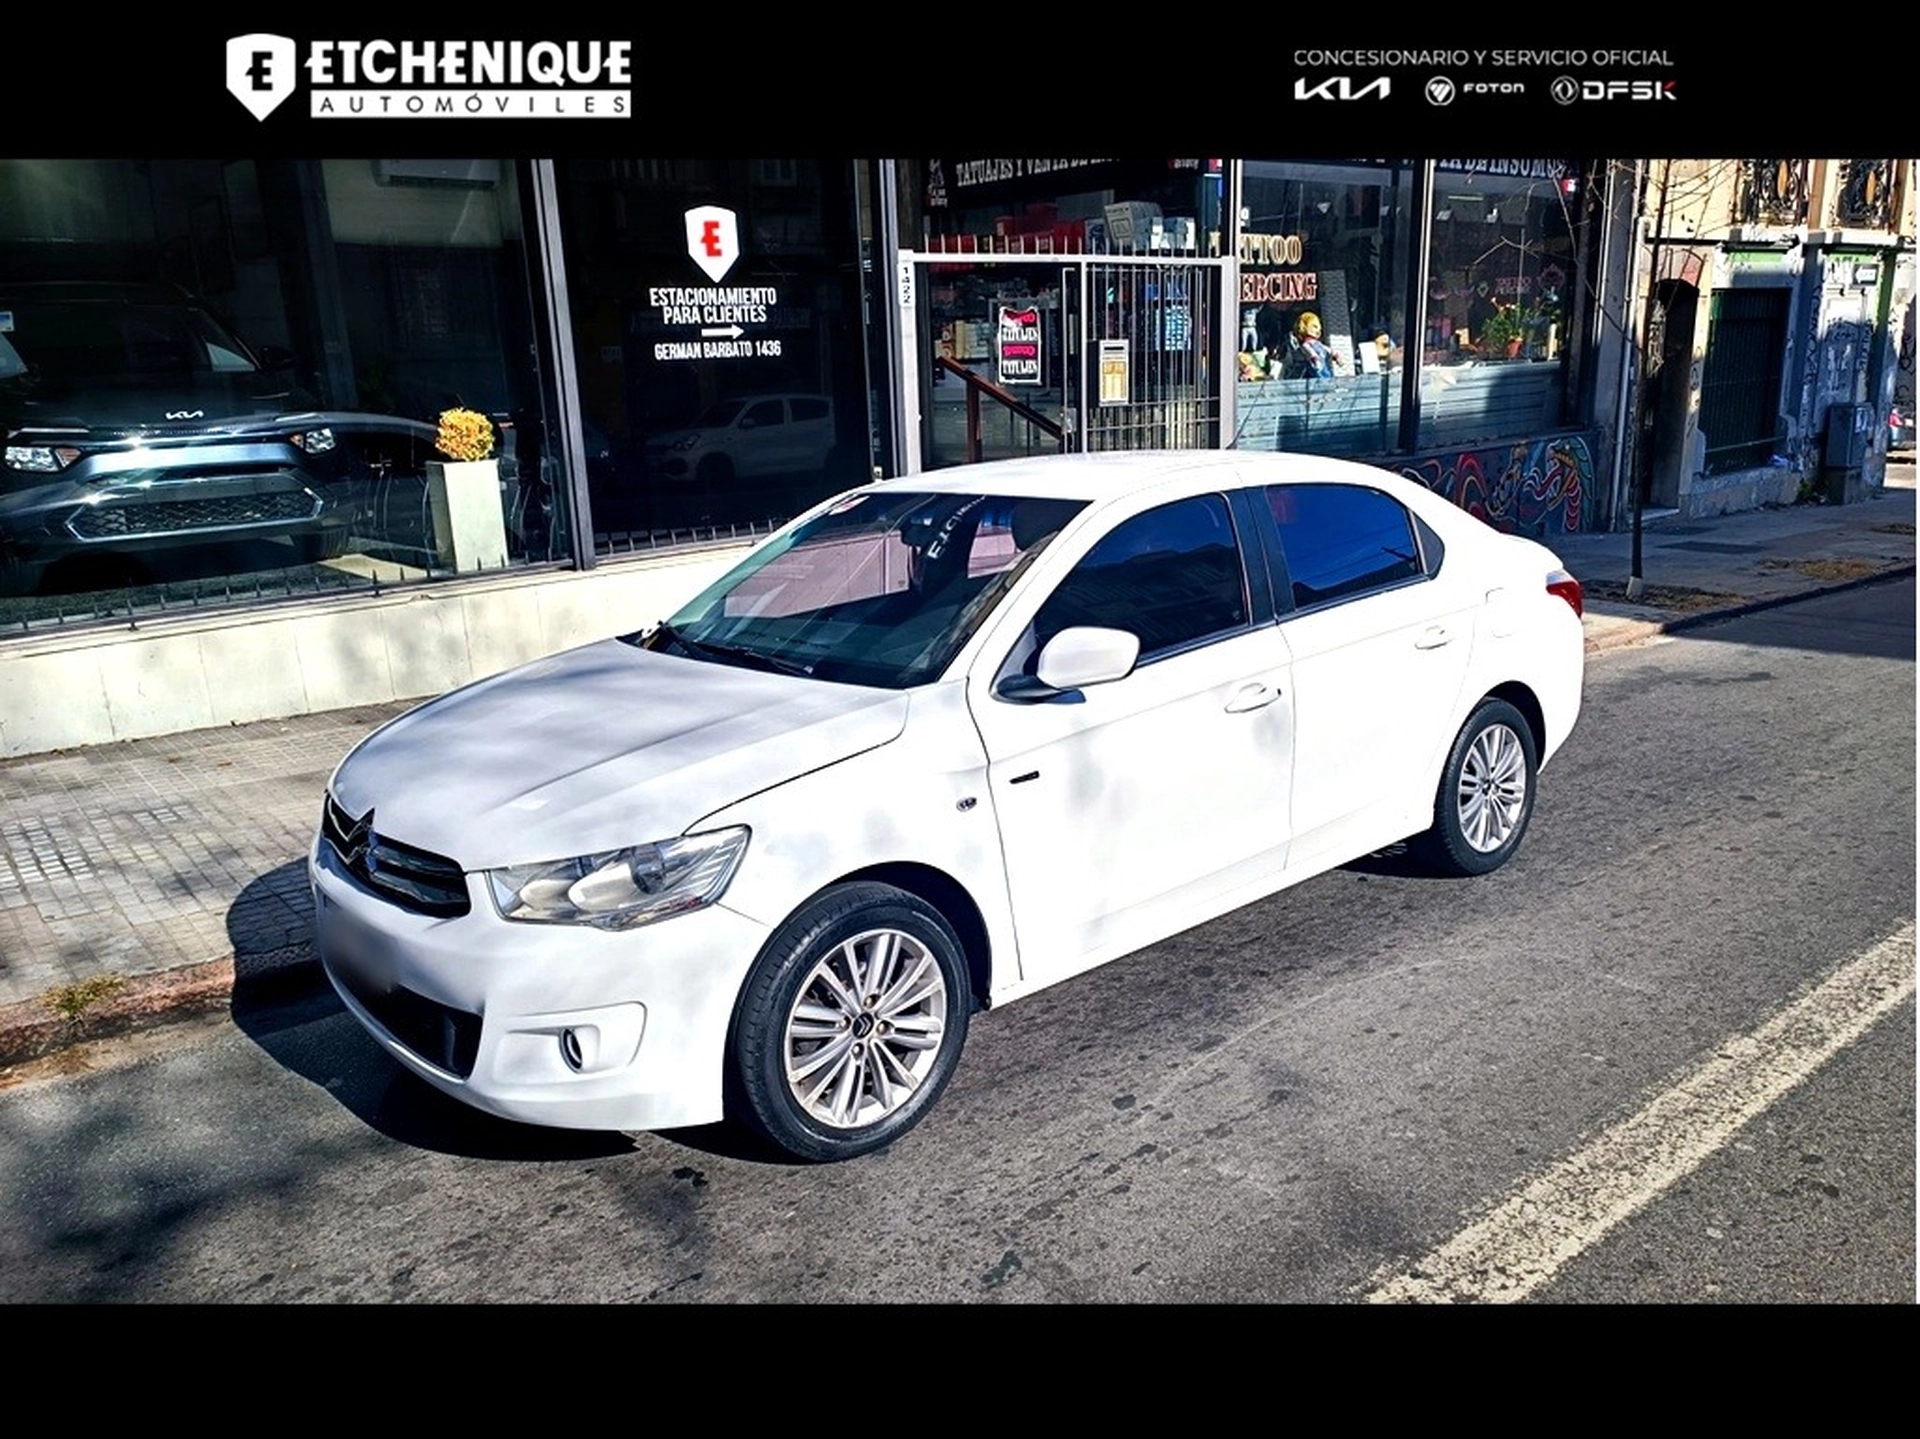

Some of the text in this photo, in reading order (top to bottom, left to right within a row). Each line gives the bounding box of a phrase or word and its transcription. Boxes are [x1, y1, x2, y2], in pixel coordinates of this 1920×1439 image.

[956, 159, 1013, 187] TATUAJES
[649, 287, 777, 307] ESTACIONAMIENTO
[1239, 272, 1318, 302] ERCING
[663, 305, 767, 324] PARA CLIENTES
[654, 340, 782, 360] GERMAN BARBATO 1436
